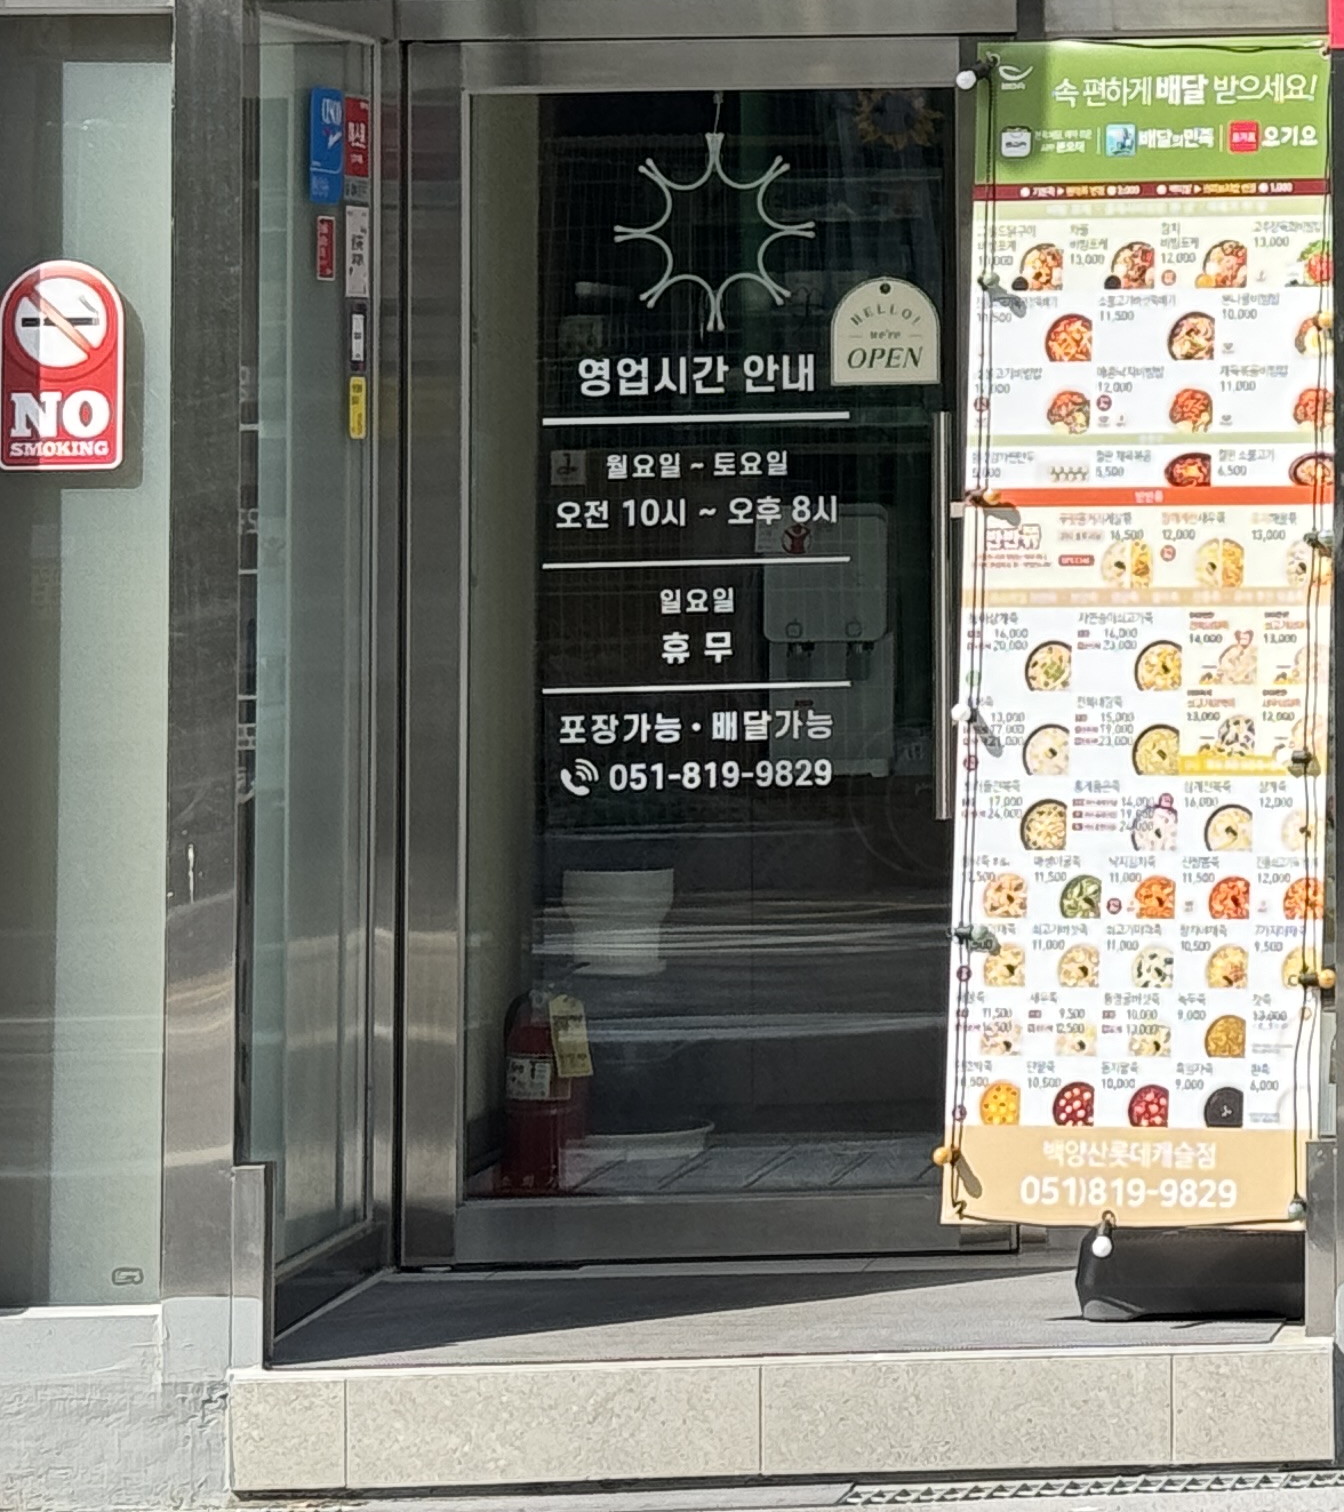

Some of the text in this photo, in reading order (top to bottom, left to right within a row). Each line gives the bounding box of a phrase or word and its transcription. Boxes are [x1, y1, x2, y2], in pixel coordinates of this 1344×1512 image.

[1053, 72, 1319, 109] 속 편하게 배달 받으세요!
[1138, 125, 1320, 150] 배달의민족 요기요
[850, 303, 922, 326] HELLO!
[847, 345, 924, 369] OPEN
[577, 353, 817, 397] 영업시간 안내
[9, 389, 111, 439] NO
[9, 440, 110, 458] SMOKING
[605, 449, 789, 482] 월요일 토요일
[555, 494, 839, 530] 오전 10시 오후 8시
[659, 586, 736, 616] 일요일
[608, 757, 834, 793] 051-819-9829
[1041, 1139, 1218, 1170] 백양산롯데캐슬점
[1020, 1176, 1238, 1210] 051)819-9829
